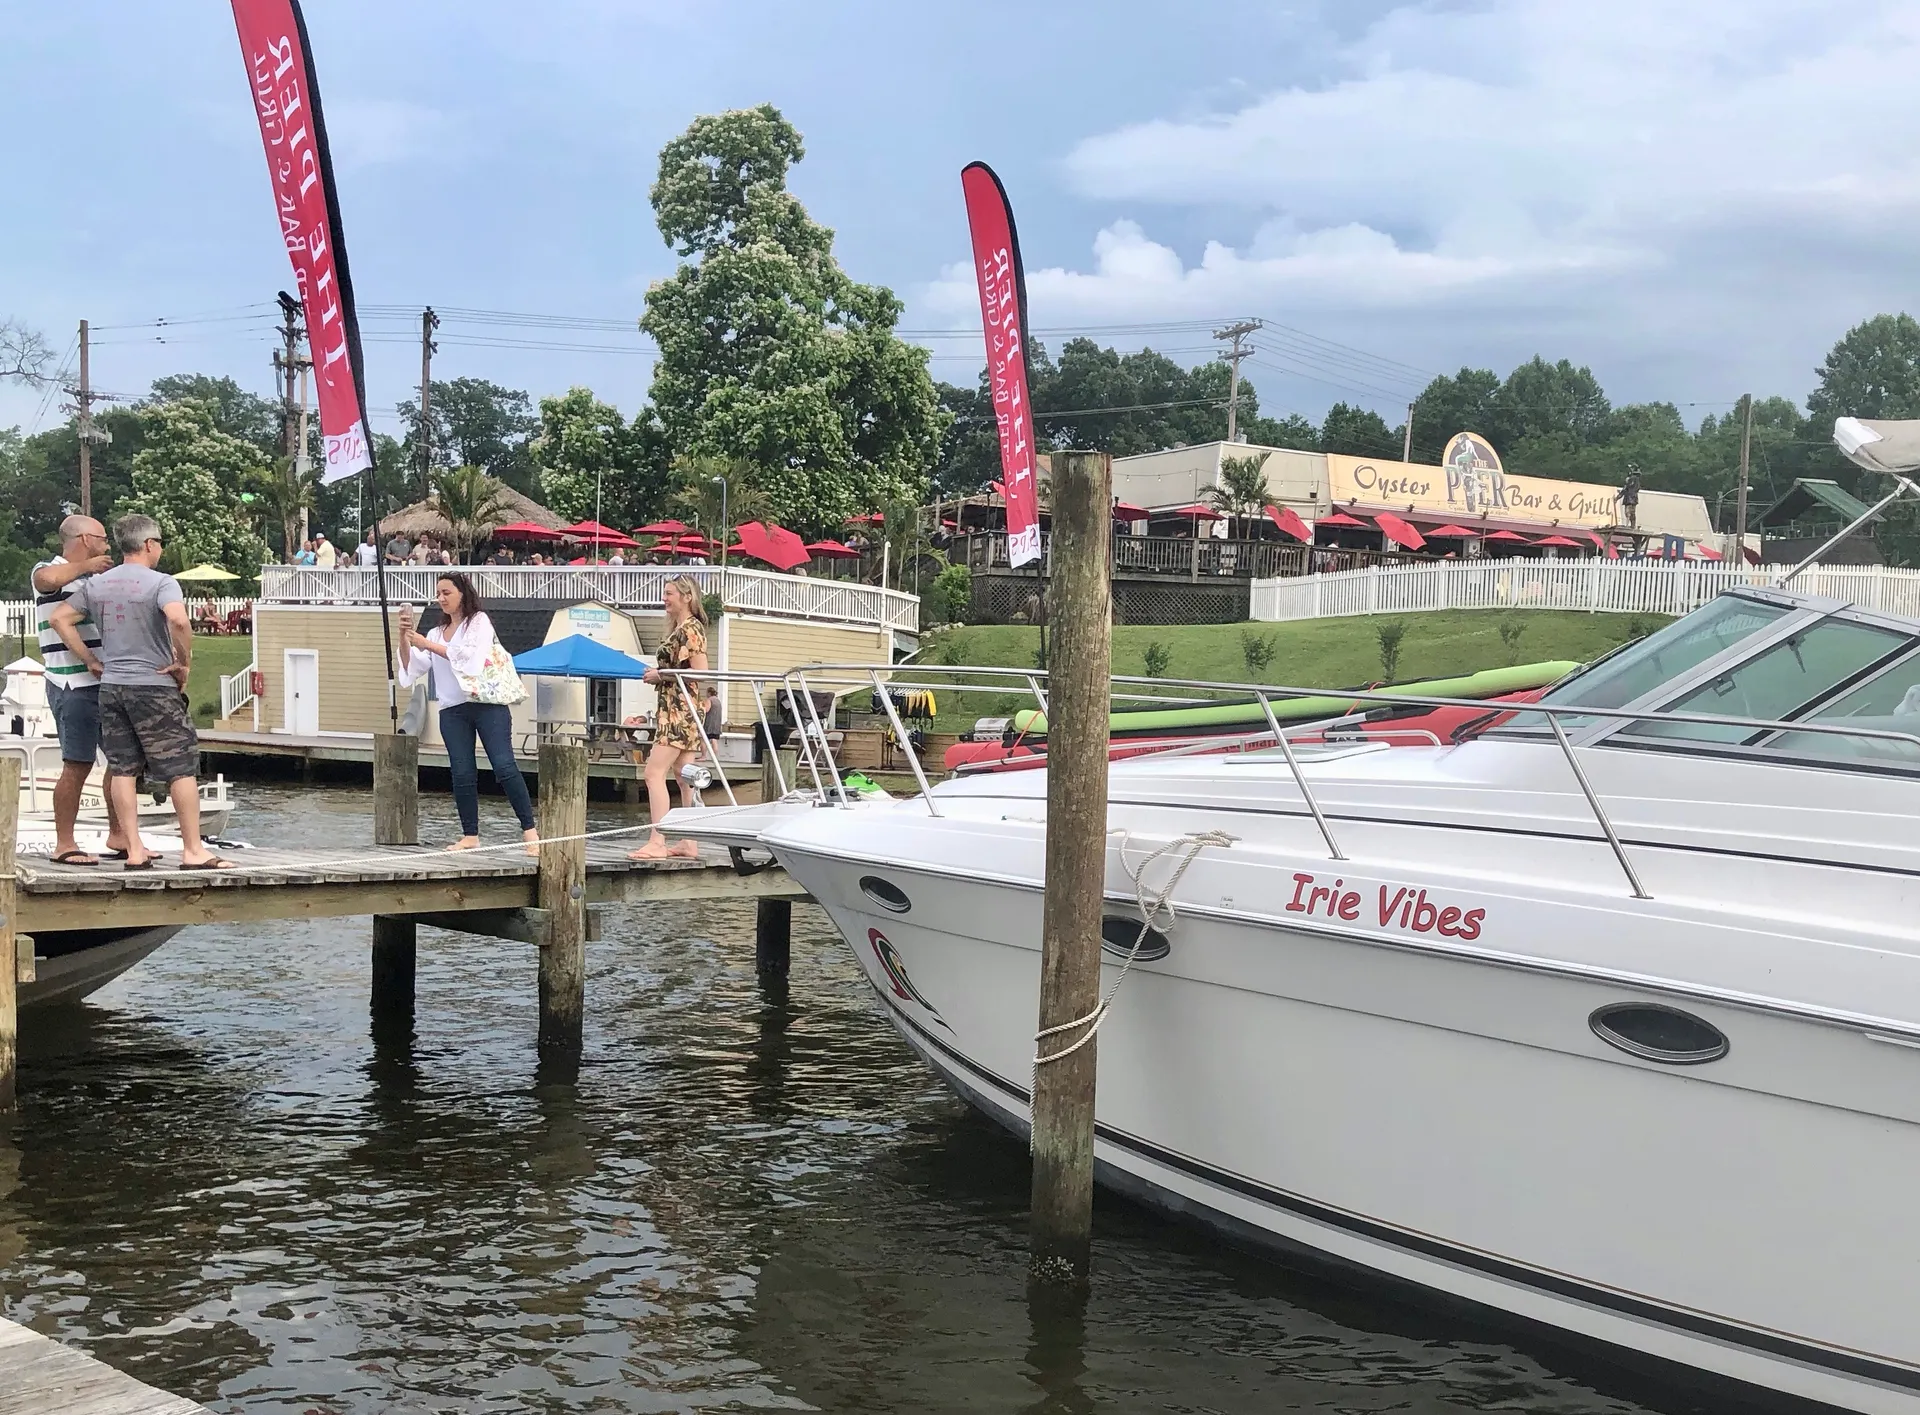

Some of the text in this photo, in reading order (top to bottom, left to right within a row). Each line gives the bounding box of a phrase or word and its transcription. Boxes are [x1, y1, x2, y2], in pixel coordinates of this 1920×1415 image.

[1353, 464, 1430, 500] Oyster
[1504, 484, 1613, 518] Bar & Grill
[1285, 872, 1486, 940] Irie Vibes
